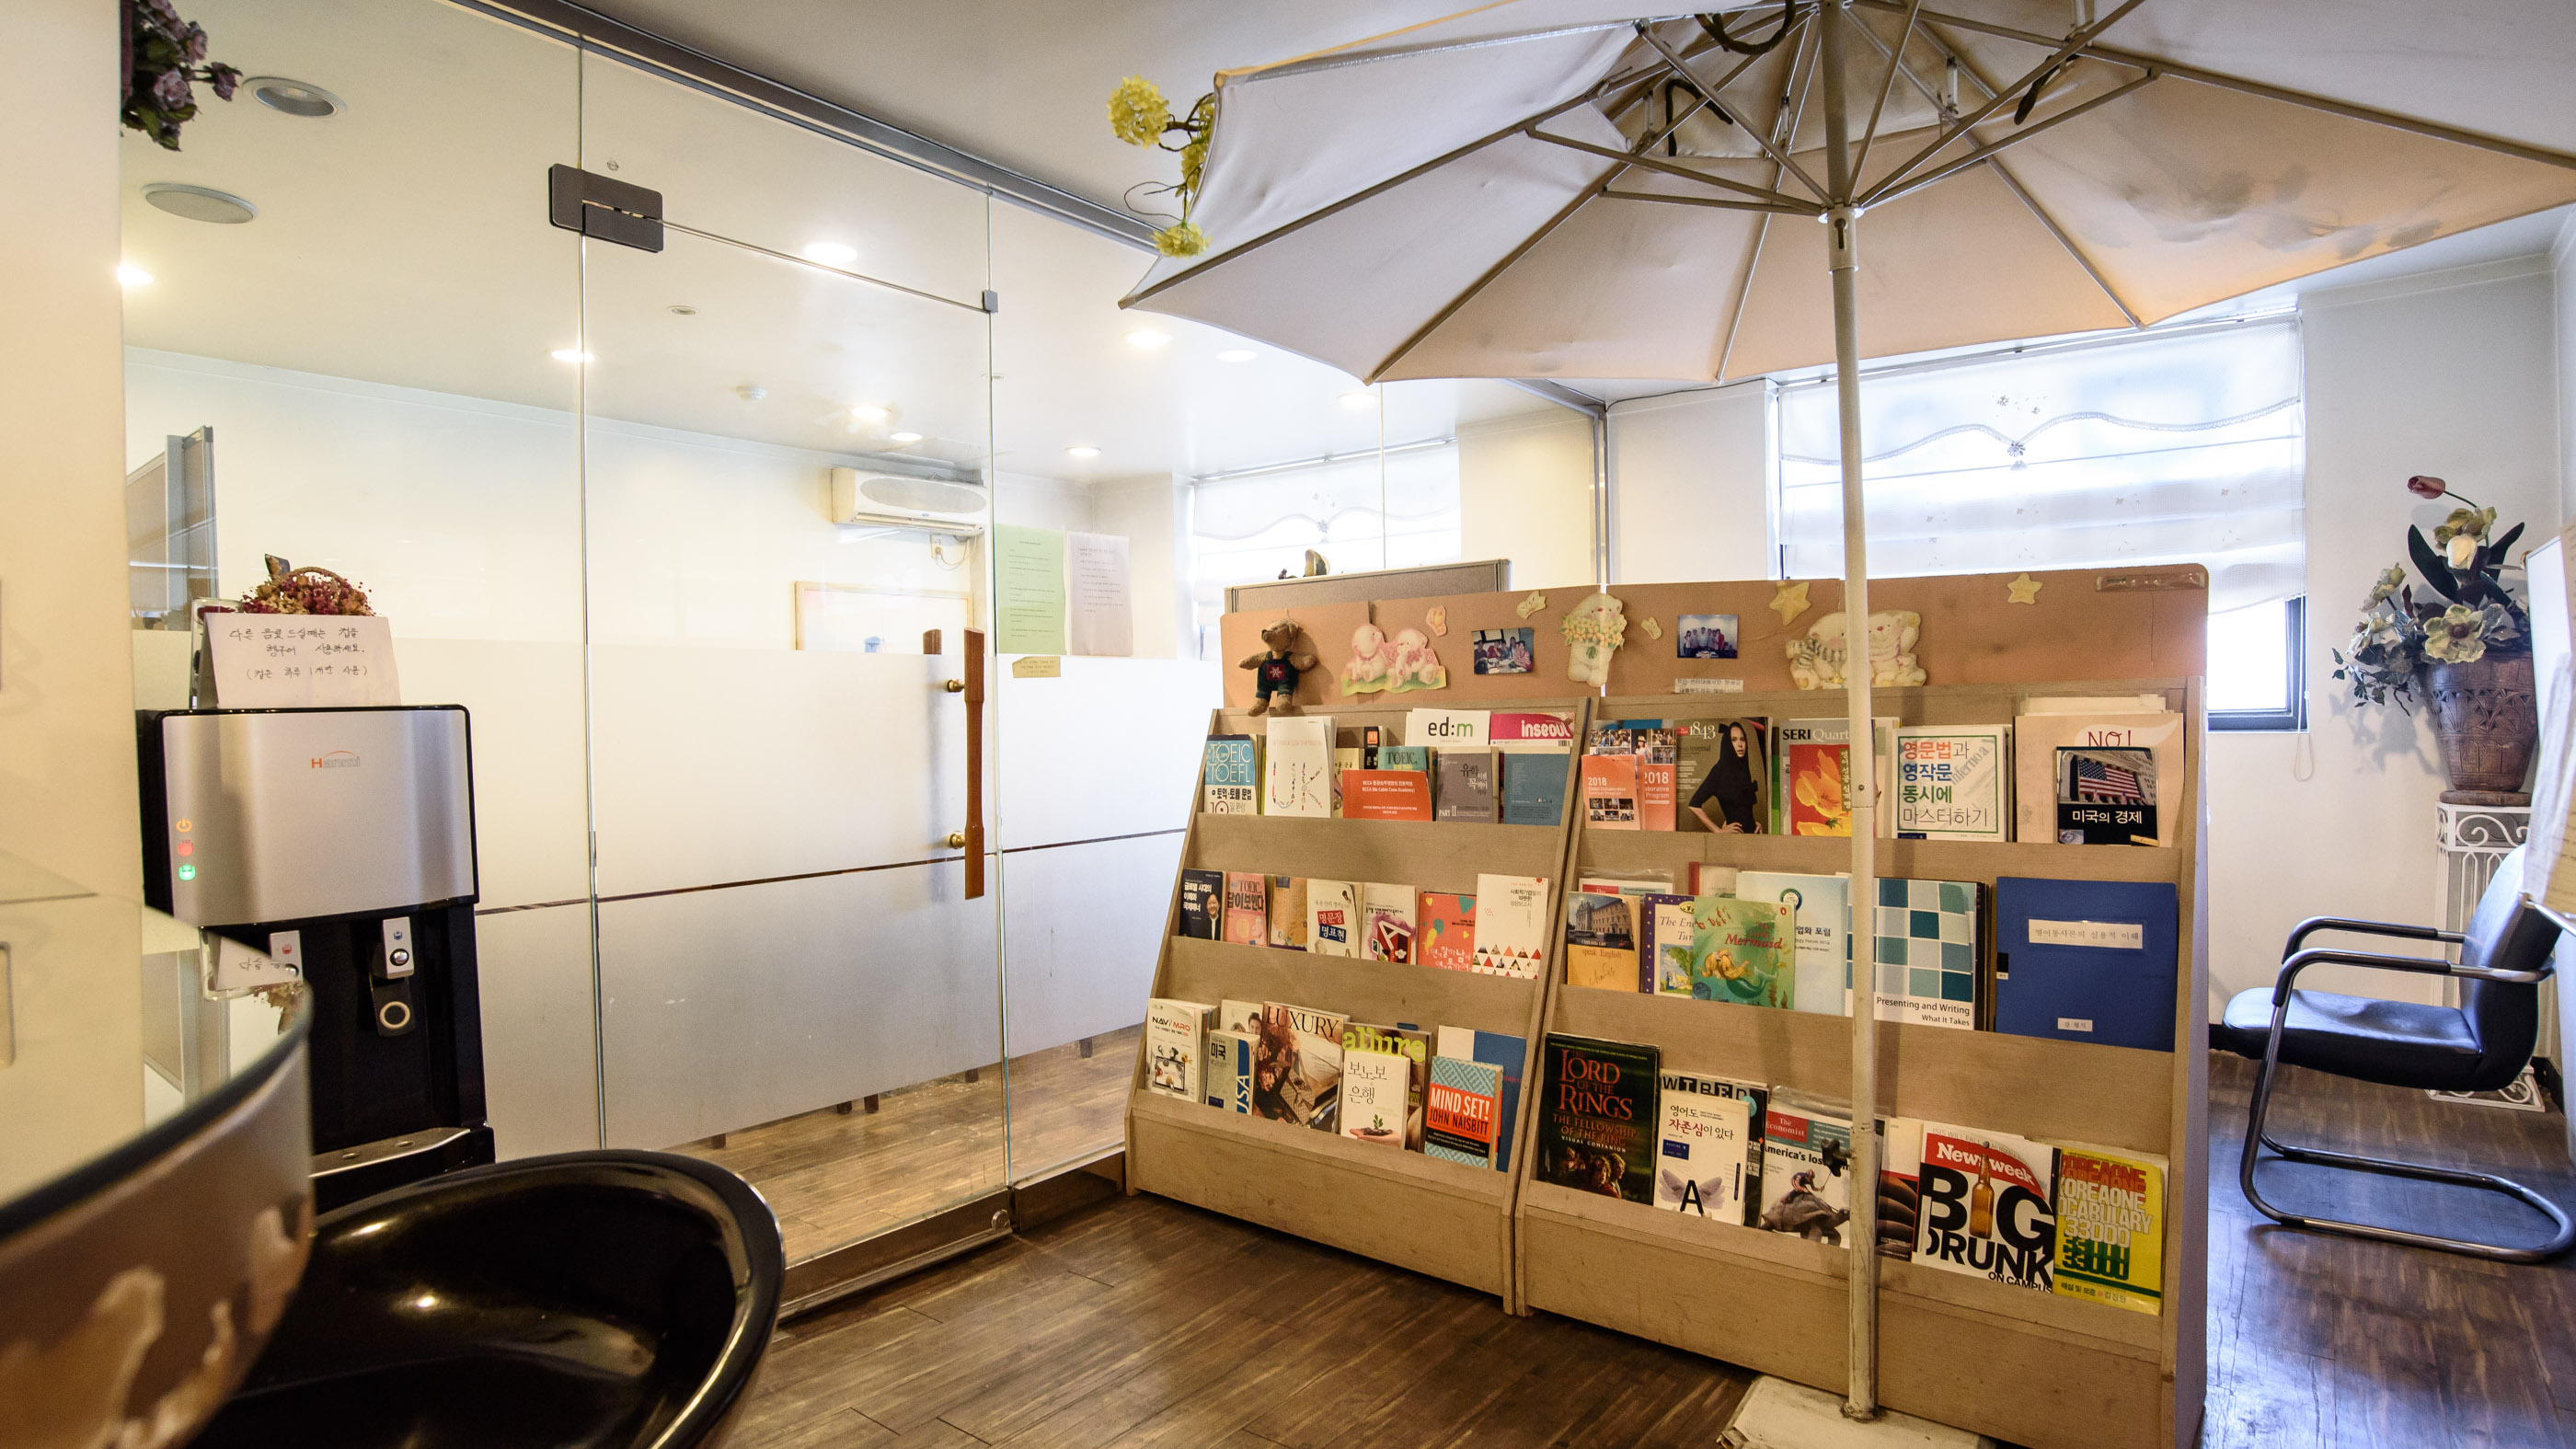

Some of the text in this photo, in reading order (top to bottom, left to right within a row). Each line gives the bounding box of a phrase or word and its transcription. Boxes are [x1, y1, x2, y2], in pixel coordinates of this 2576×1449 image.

[229, 628, 253, 641] 다른
[339, 627, 359, 638] 컵을
[284, 666, 301, 677] 하루
[1428, 717, 1473, 737] ed:m
[1522, 720, 1570, 737] inseoul
[1689, 720, 1716, 740] 1843
[1782, 729, 1811, 741] SERI
[1210, 743, 1251, 764] TOEIC
[1903, 741, 1971, 760] 영문법과
[1210, 763, 1250, 783] TOEFL
[1588, 776, 1607, 786] 2018
[1903, 763, 1952, 782] 영작문
[1903, 785, 1952, 804] 동시에
[1903, 807, 1987, 827] 마스터하기
[2072, 810, 2143, 825] 미국의 경제
[1318, 912, 1343, 925] 명문장
[1660, 916, 1676, 926] The
[1321, 926, 1345, 942] 명표현
[1724, 933, 1783, 949] Mermaid
[1815, 927, 1831, 937] 포럼
[2121, 932, 2139, 940] 이해
[1601, 949, 1622, 960] English
[1877, 996, 1970, 1017] Presenting and Writing
[1172, 1021, 1190, 1031] MRO
[1266, 1006, 1340, 1044] LUXURY
[1922, 1014, 1940, 1023] What
[1949, 1017, 1970, 1026] Takes
[1211, 1042, 1226, 1061] 미국
[1342, 1026, 1426, 1063] allure
[1348, 1061, 1387, 1080] 보노보
[1559, 1048, 1621, 1085] LORD
[1348, 1086, 1375, 1105] 은행
[1577, 1080, 1615, 1095] OF THE
[1662, 1075, 1748, 1101] WIRED
[1431, 1087, 1490, 1121] MIND SET!
[1557, 1083, 1633, 1121] RINGS
[1670, 1104, 1699, 1119] 영어도
[1429, 1108, 1489, 1136] JOHN NAISBITT
[1553, 1112, 1637, 1138] THE FELLOWSHIP
[1668, 1118, 1735, 1141] 자존심이 있다
[1779, 1117, 1793, 1127] The
[1560, 1125, 1627, 1146] OF THE RING
[1932, 1128, 1947, 1136] ISIS
[1948, 1131, 1963, 1141] WILL
[1561, 1135, 1627, 1154] VISUAL COMPANION
[1809, 1153, 1824, 1166] los
[1679, 1179, 1706, 1218] A
[2064, 1215, 2131, 1248] 33000
[1988, 1271, 2053, 1294] ON CAMPUS
[2076, 1284, 2082, 1293] 및
